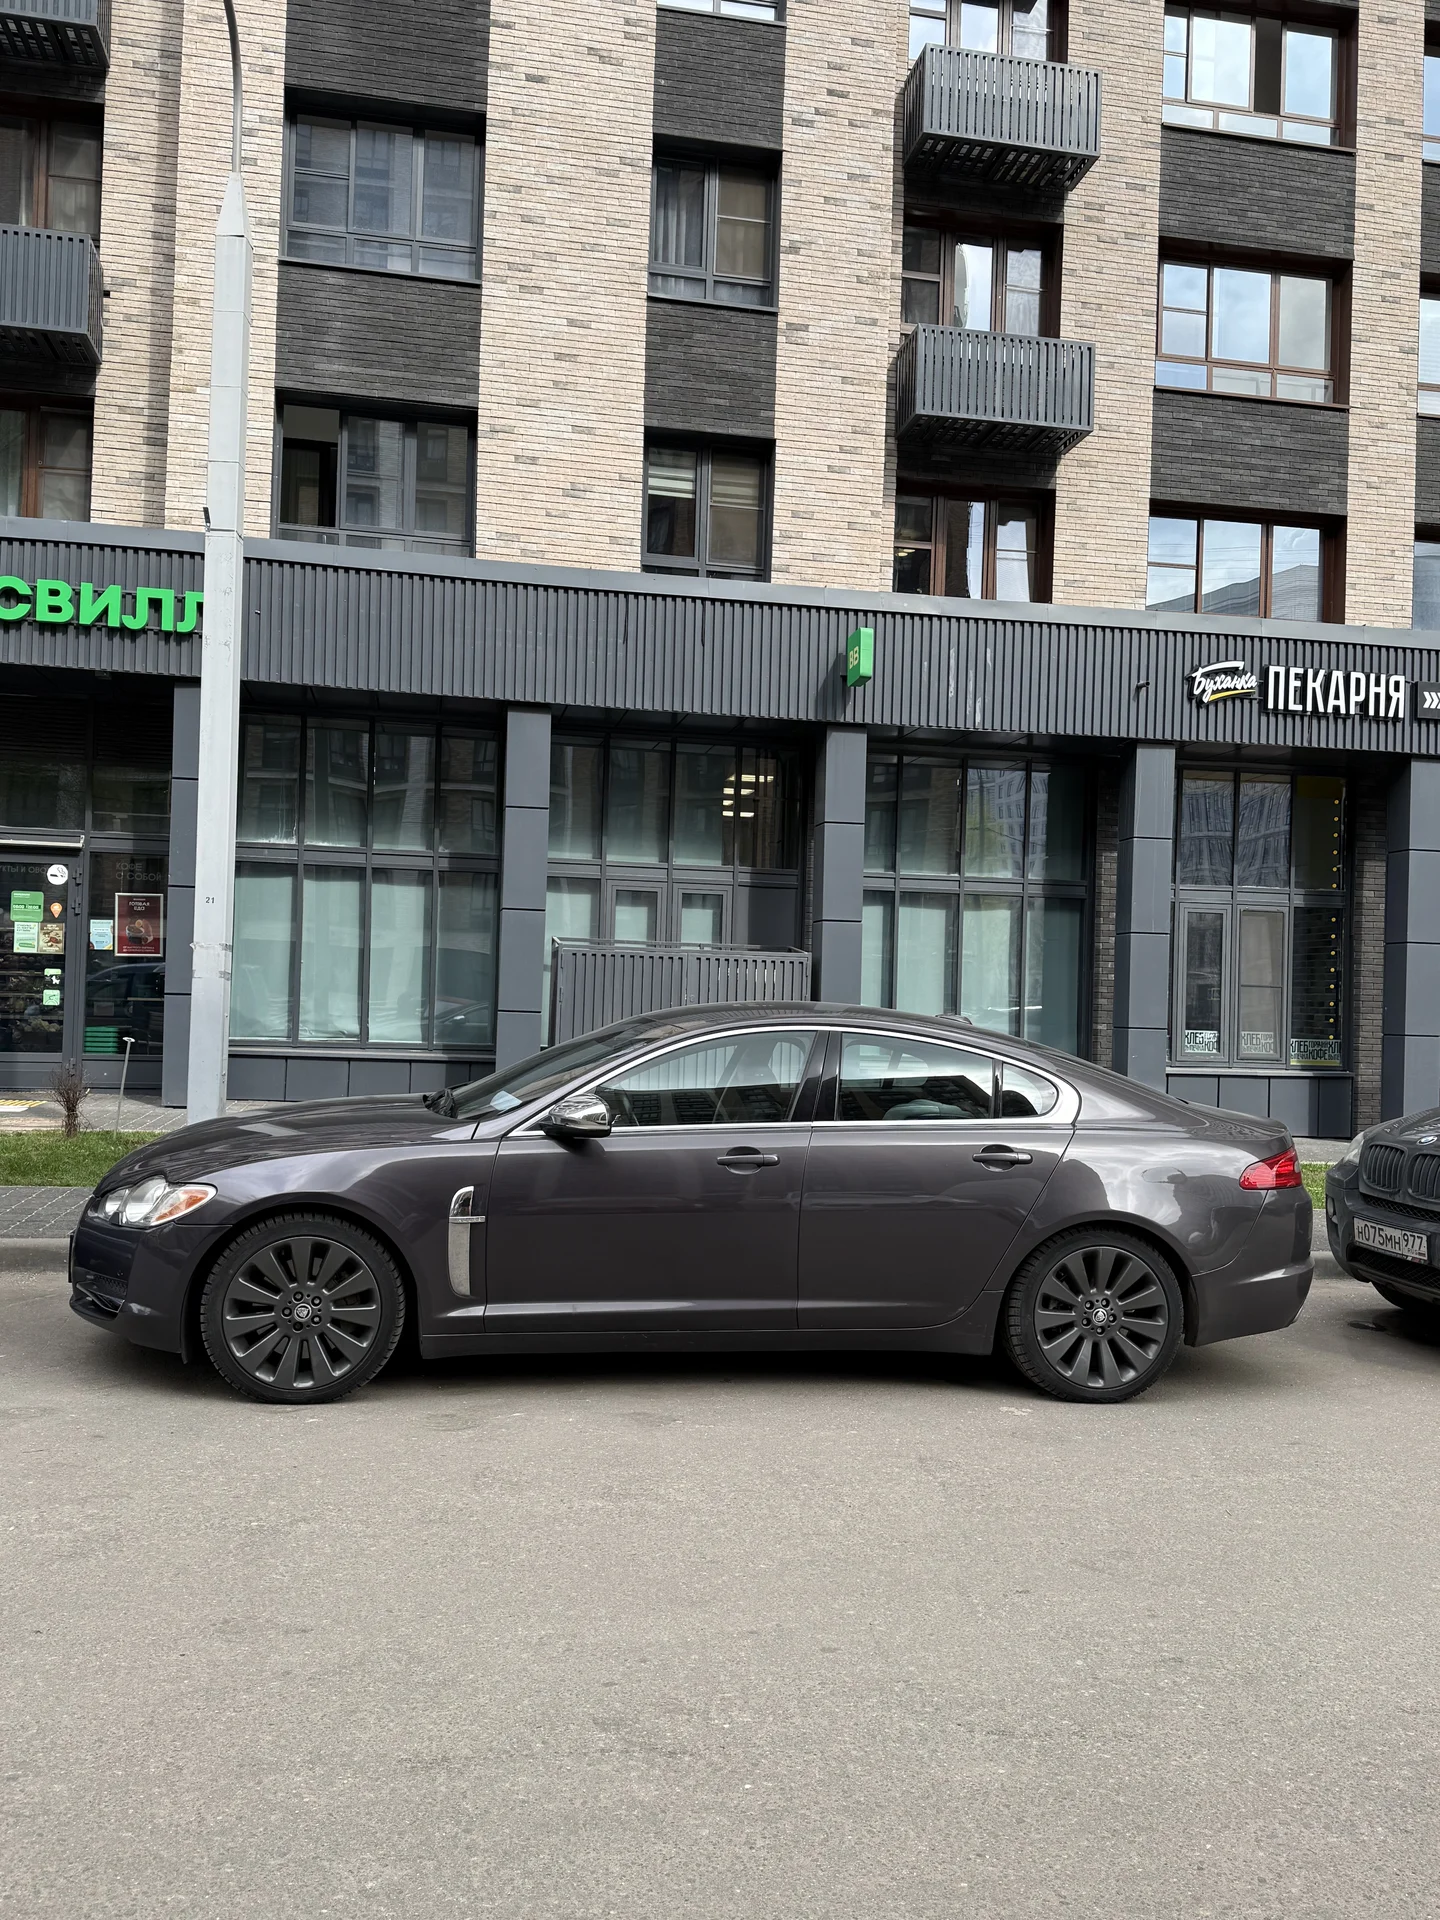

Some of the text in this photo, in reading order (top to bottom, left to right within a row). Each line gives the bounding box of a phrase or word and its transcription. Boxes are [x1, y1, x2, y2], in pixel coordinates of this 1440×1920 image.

[1191, 660, 1406, 719] Буханка ПЕКАРНЯ
[205, 896, 215, 904] 21
[1308, 1048, 1328, 1060] КОФЕ
[1402, 1232, 1424, 1251] 977
